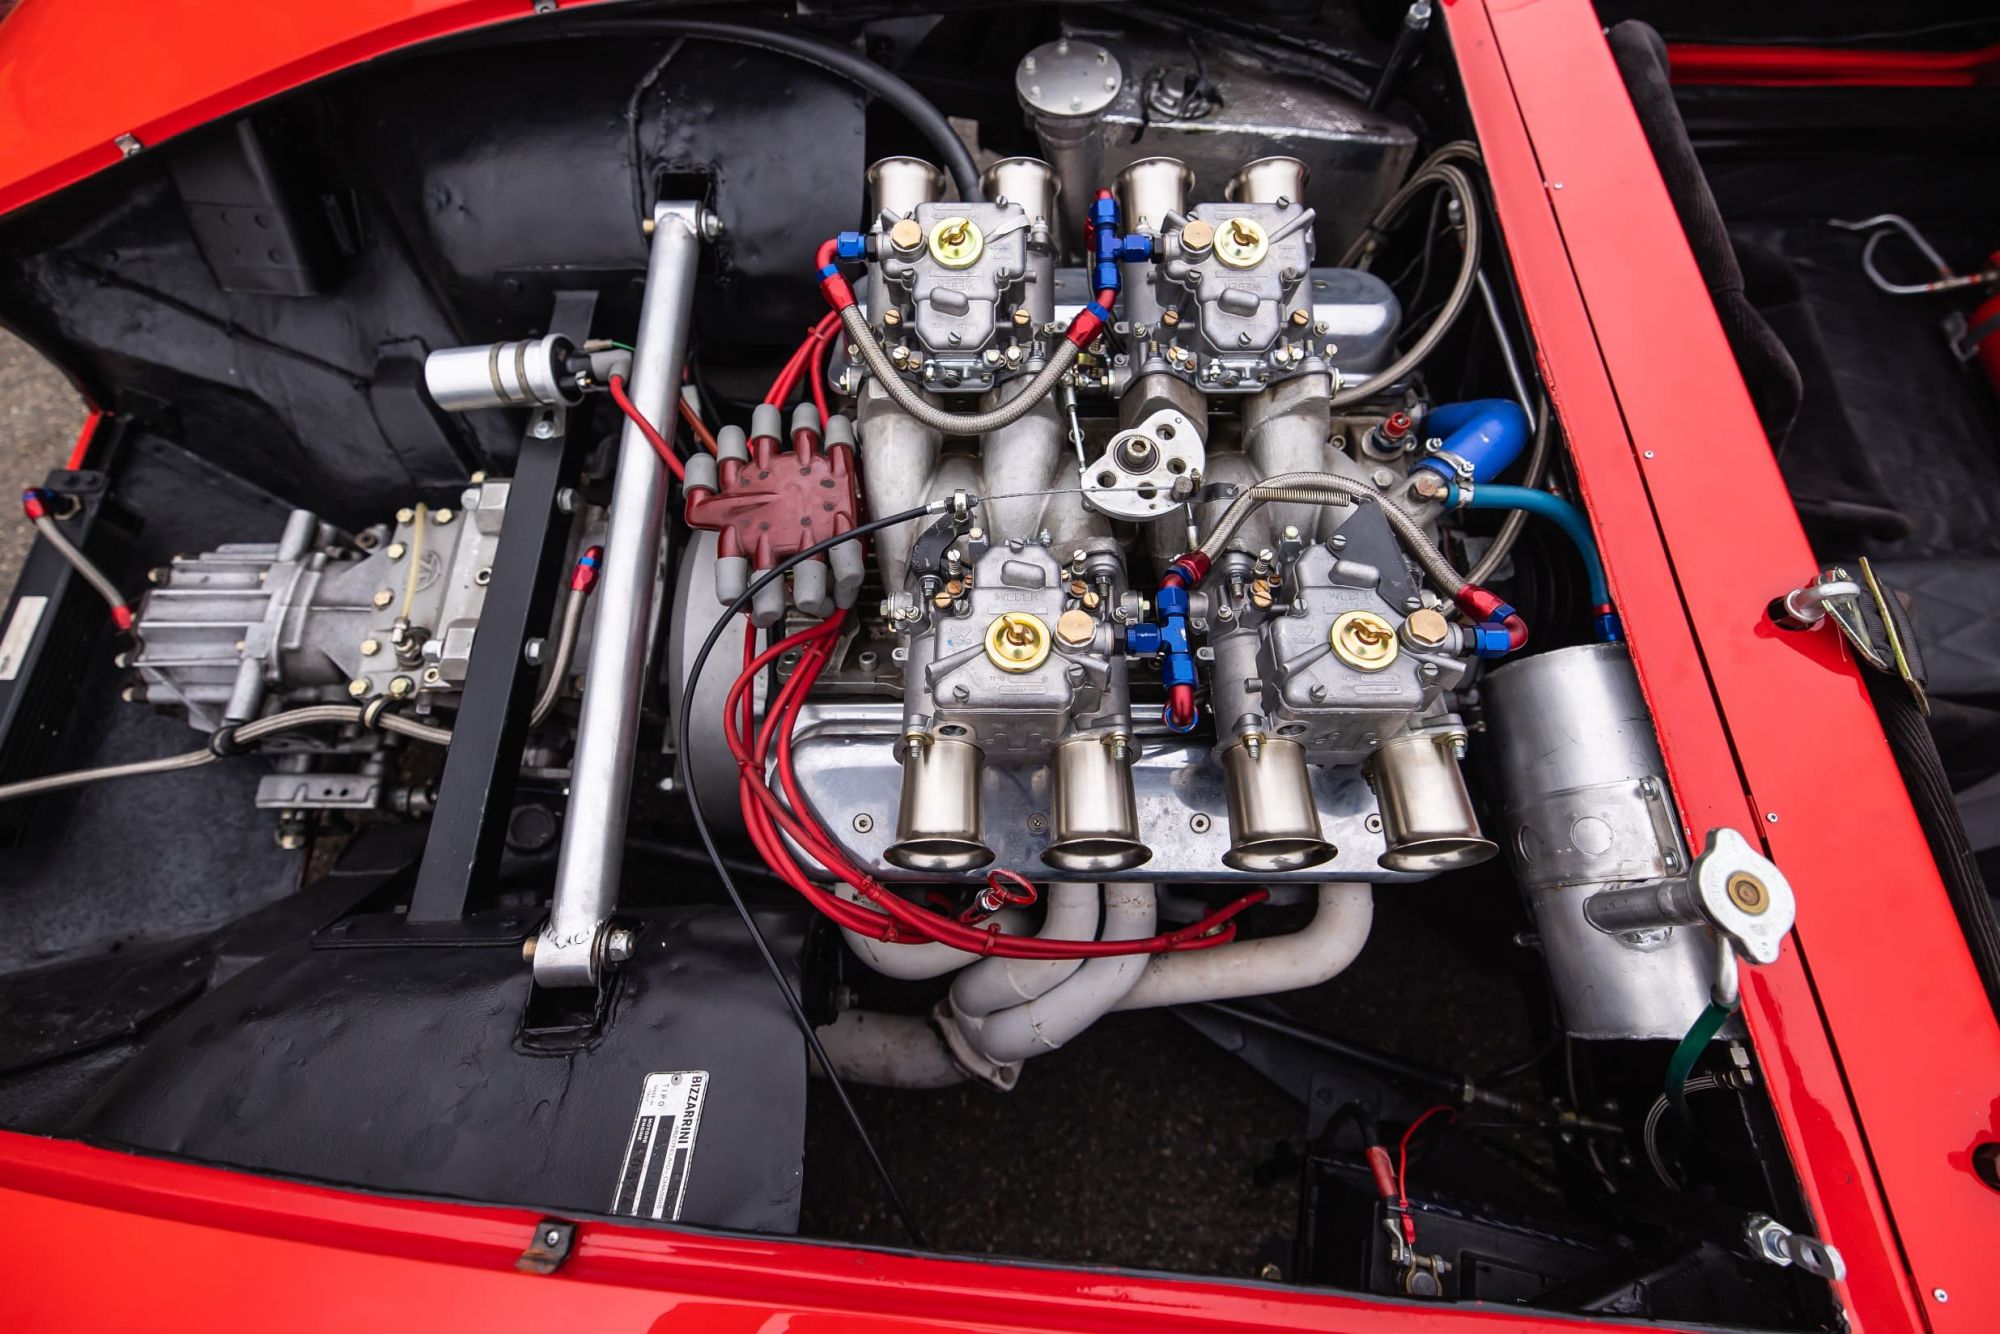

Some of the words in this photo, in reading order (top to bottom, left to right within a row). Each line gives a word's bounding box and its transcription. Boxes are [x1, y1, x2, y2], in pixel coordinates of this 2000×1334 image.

[994, 592, 1040, 601] WEBER
[658, 1083, 670, 1107] TIPO
[677, 1076, 702, 1144] BIZZARRINI
[642, 1118, 653, 1144] MOTORE
